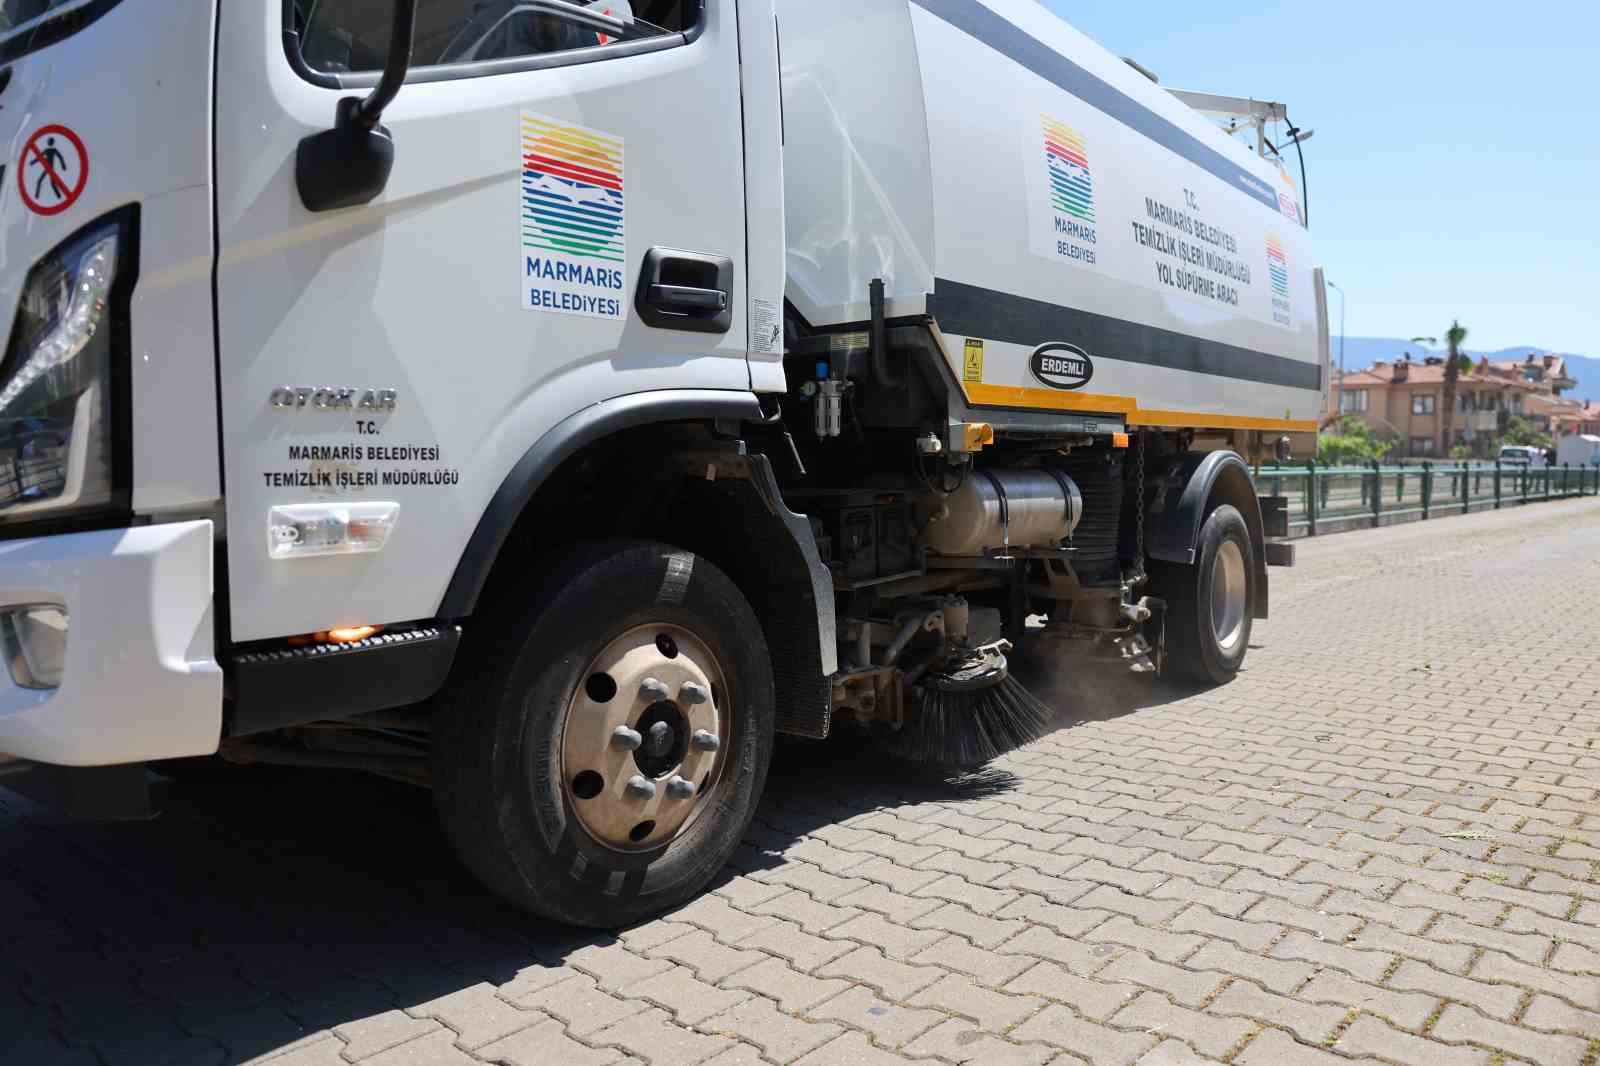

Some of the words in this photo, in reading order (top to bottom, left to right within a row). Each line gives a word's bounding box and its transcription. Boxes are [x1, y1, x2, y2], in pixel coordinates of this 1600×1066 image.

[1144, 196, 1193, 235] MARMARİS
[1131, 220, 1177, 257] TEMİZLİK
[1155, 260, 1175, 287] YOL
[1175, 266, 1215, 299] SÜPÜRME
[269, 386, 397, 410] OTOKAR
[356, 420, 380, 435] T.C.
[289, 443, 363, 460] MARMARİS
[367, 444, 440, 460] BELEDİYESİ
[263, 468, 332, 487] TEMİZLİK
[336, 469, 378, 489] İŞLERİ
[382, 469, 459, 485] MÜDÜRLÜĞÜ
